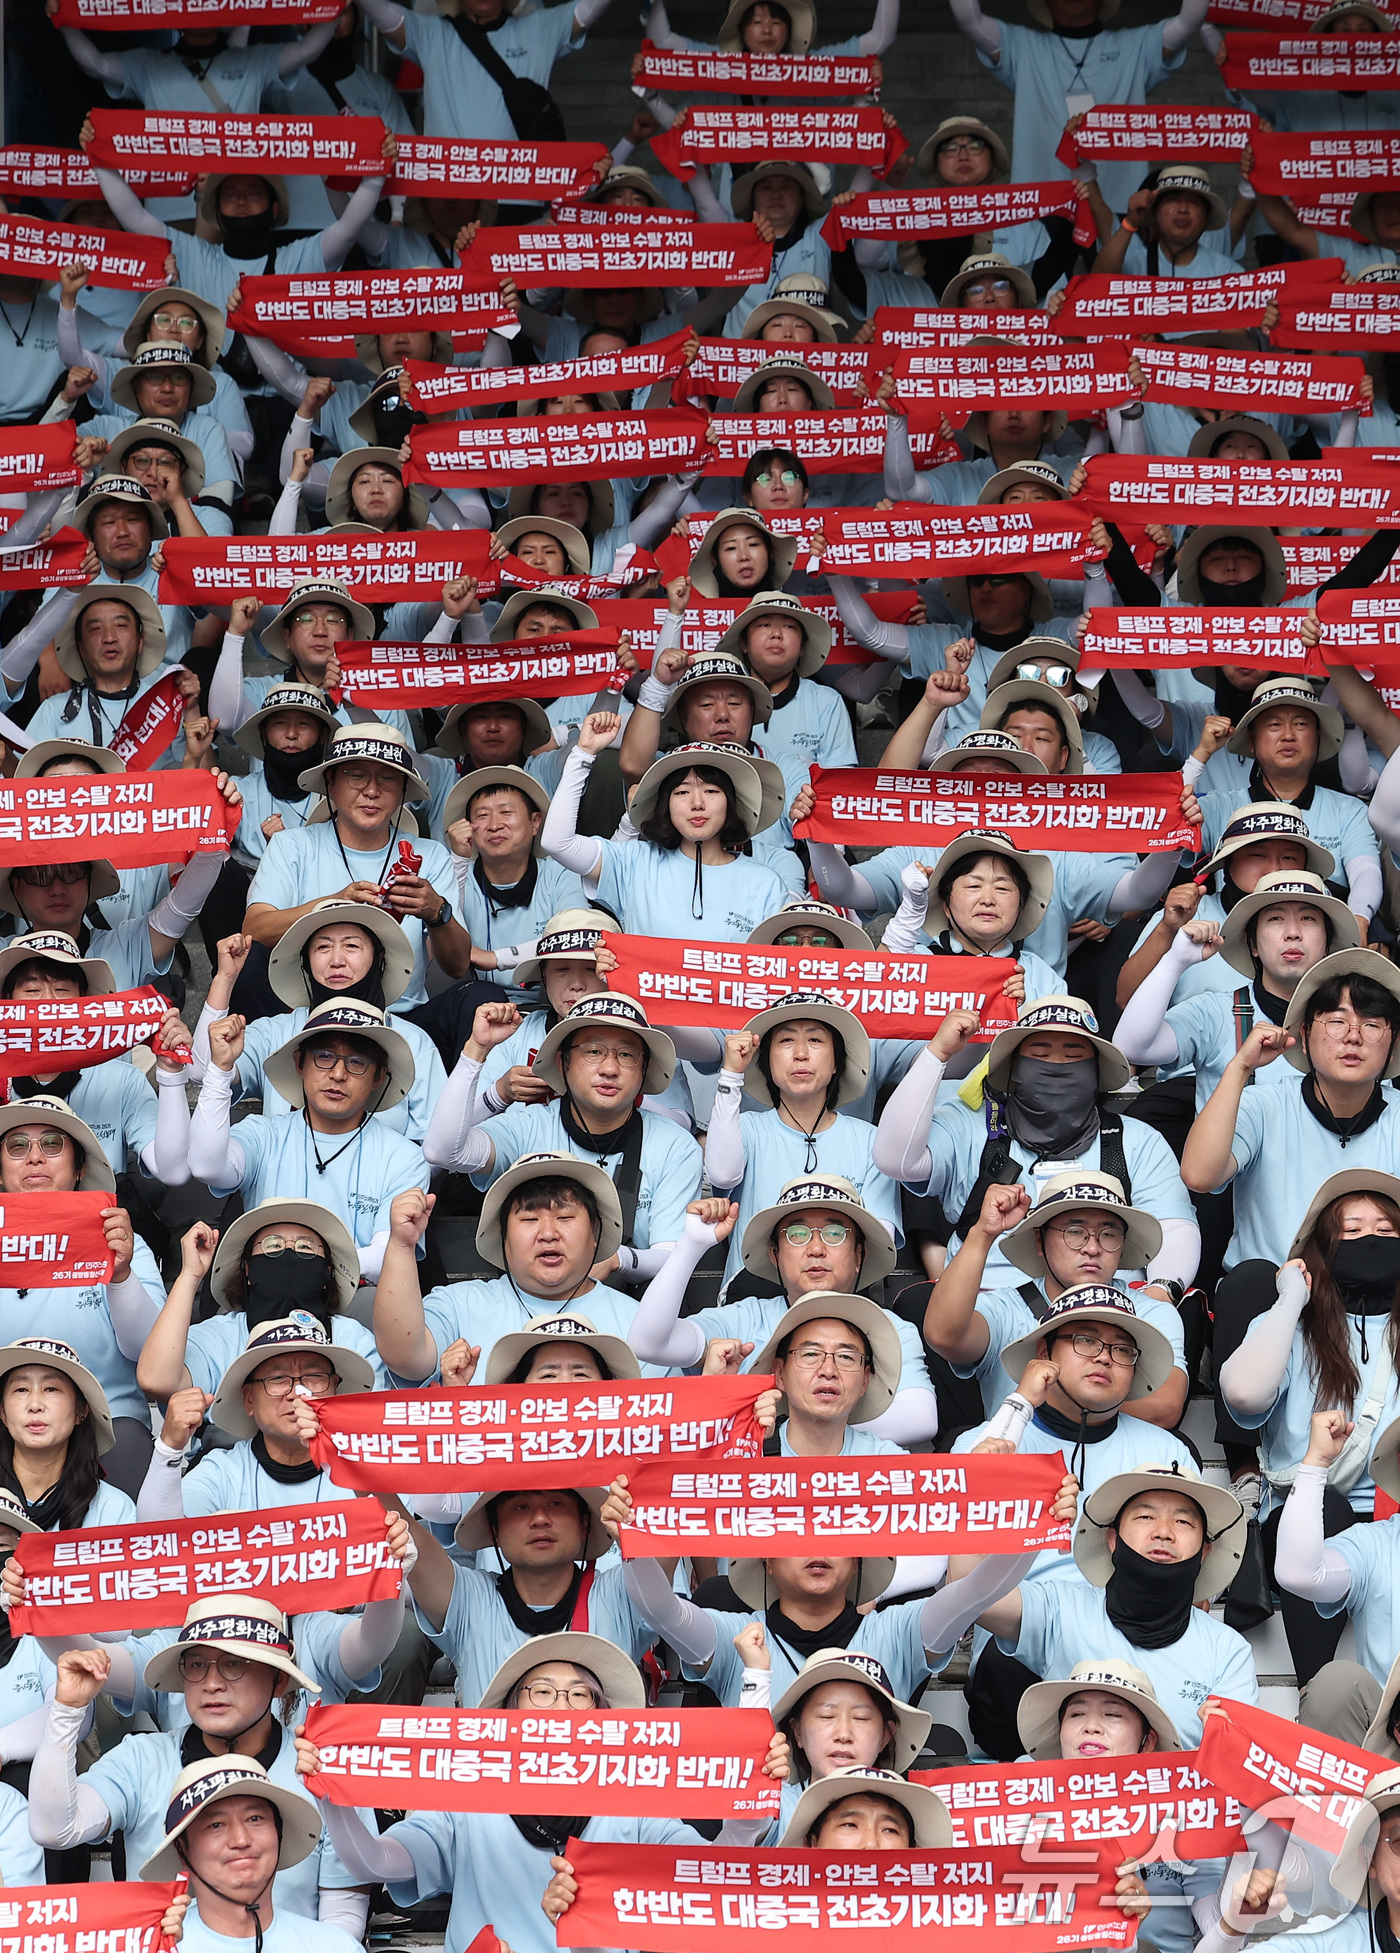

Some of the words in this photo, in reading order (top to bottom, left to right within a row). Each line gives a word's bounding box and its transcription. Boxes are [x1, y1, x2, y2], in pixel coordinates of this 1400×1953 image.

[144, 117, 185, 133] 트럼프
[188, 119, 252, 135] 경제·안보
[255, 122, 283, 136] 수탈
[286, 122, 312, 136] 저지
[1086, 112, 1126, 128] 트럼프
[1129, 114, 1192, 128] 경제·안보
[1195, 114, 1222, 128] 수탈
[1224, 114, 1250, 128] 저지
[112, 134, 170, 154] 한반도
[169, 137, 221, 156] 대중국
[224, 139, 309, 158] 전초기지화
[313, 140, 355, 158] 반대!
[1113, 132, 1163, 147] 대중국
[1166, 132, 1248, 148] 전초기지화
[1310, 140, 1350, 155] 트럼프
[396, 162, 446, 181] 대중국
[449, 164, 531, 184] 전초기지화
[535, 167, 576, 184] 반대!
[1280, 159, 1334, 178] 한반도
[1336, 159, 1388, 178] 대중국
[868, 198, 910, 213] 트럼프
[912, 194, 978, 211] 경제·안보
[981, 192, 1010, 206] 수탈
[1012, 190, 1038, 204] 저지
[518, 234, 561, 249] 트럼프
[563, 233, 630, 248] 경제·안보
[633, 232, 662, 247] 수탈
[665, 231, 692, 246] 저지
[101, 256, 145, 276] 반대!
[490, 253, 544, 272] 한반도
[547, 253, 599, 270] 대중국
[603, 251, 688, 269] 전초기지화
[691, 251, 735, 269] 반대!
[255, 301, 310, 320] 한반도
[313, 300, 366, 319] 대중국
[370, 295, 458, 318] 전초기지화
[415, 375, 468, 399] 한반도
[471, 368, 525, 390] 대중국
[528, 358, 617, 383] 전초기지화
[621, 354, 665, 373] 반대!
[1156, 369, 1210, 390] 대중국
[1214, 375, 1304, 398] 전초기지화
[1307, 381, 1354, 401] 반대!
[458, 429, 504, 446] 트럼프
[507, 425, 579, 444] 경제·안보
[582, 422, 613, 439] 수탈
[615, 420, 646, 436] 저지
[426, 451, 487, 470] 한반도
[489, 448, 547, 469] 대중국
[550, 440, 645, 466] 전초기지화
[648, 436, 695, 458] 반대!
[1147, 464, 1194, 478] 트럼프
[1198, 465, 1272, 480] 경제·안보
[1275, 468, 1308, 481] 수탈
[1311, 468, 1342, 482] 저지
[1109, 481, 1169, 503] 한반도
[1174, 484, 1234, 505] 대중국
[1238, 485, 1336, 507] 전초기지화
[1339, 488, 1390, 508] 반대!
[226, 545, 272, 562] 트럼프
[275, 544, 347, 562] 경제·안보
[351, 543, 383, 560] 수탈
[386, 541, 416, 558] 저지
[874, 541, 931, 561] 대중국
[935, 535, 1029, 558] 전초기지화
[1032, 532, 1081, 552] 반대!
[192, 566, 252, 587] 한반도
[332, 740, 404, 764] 자주평화실현
[874, 775, 931, 793] 트럼프
[936, 779, 1023, 796] 경제·안보
[1027, 783, 1065, 798] 수탈
[1069, 783, 1105, 799] 저지
[27, 810, 147, 840] 전초기지화
[152, 805, 211, 832] 반대!
[831, 795, 904, 821] 한반도
[909, 800, 979, 826] 대중국
[984, 803, 1101, 828] 전초기지화
[1105, 806, 1166, 830] 반대!
[682, 948, 741, 974] 트럼프
[746, 955, 838, 980] 경제·안보
[843, 961, 885, 982] 수탈
[888, 962, 927, 983] 저지
[638, 971, 712, 1003] 한반도
[2, 1234, 68, 1262] 반대!
[1051, 1288, 1134, 1316] 자주평화실현
[383, 1401, 453, 1425] 트럼프
[459, 1398, 568, 1425] 경제·안보
[573, 1396, 623, 1420] 수탈
[626, 1393, 672, 1417] 저지
[331, 1432, 420, 1463] 한반도
[426, 1432, 514, 1464] 대중국
[520, 1424, 663, 1461] 전초기지화
[670, 1474, 742, 1498] 트럼프
[748, 1472, 861, 1498] 경제·안보
[866, 1470, 914, 1495] 수탈
[919, 1468, 966, 1493] 저지
[715, 1506, 805, 1536] 대중국
[812, 1502, 960, 1535] 전초기지화
[967, 1500, 1040, 1531] 반대!
[53, 1538, 124, 1566] 트럼프
[129, 1527, 242, 1560] 경제·안보
[246, 1520, 295, 1548] 수탈
[299, 1513, 346, 1541] 저지
[99, 1565, 188, 1600] 대중국
[194, 1548, 340, 1593] 전초기지화
[376, 1718, 451, 1739] 트럼프
[457, 1718, 571, 1743] 경제·안보
[576, 1720, 628, 1745] 수탈
[632, 1721, 680, 1746] 저지
[319, 1745, 412, 1778] 한반도
[419, 1748, 512, 1782] 대중국
[518, 1752, 670, 1787] 전초기지화
[676, 1756, 753, 1788] 반대!
[1296, 1743, 1368, 1792] 트럼프
[974, 1811, 1065, 1846] 대중국
[1071, 1798, 1218, 1845] 전초기지화
[674, 1859, 751, 1885] 트럼프
[757, 1864, 878, 1886] 경제·안보
[884, 1863, 937, 1886] 수탈
[943, 1861, 992, 1885] 저지
[26, 1897, 77, 1925] 저지
[613, 1888, 716, 1925] 한반도
[722, 1894, 820, 1929] 대중국
[827, 1893, 987, 1928] 전초기지화
